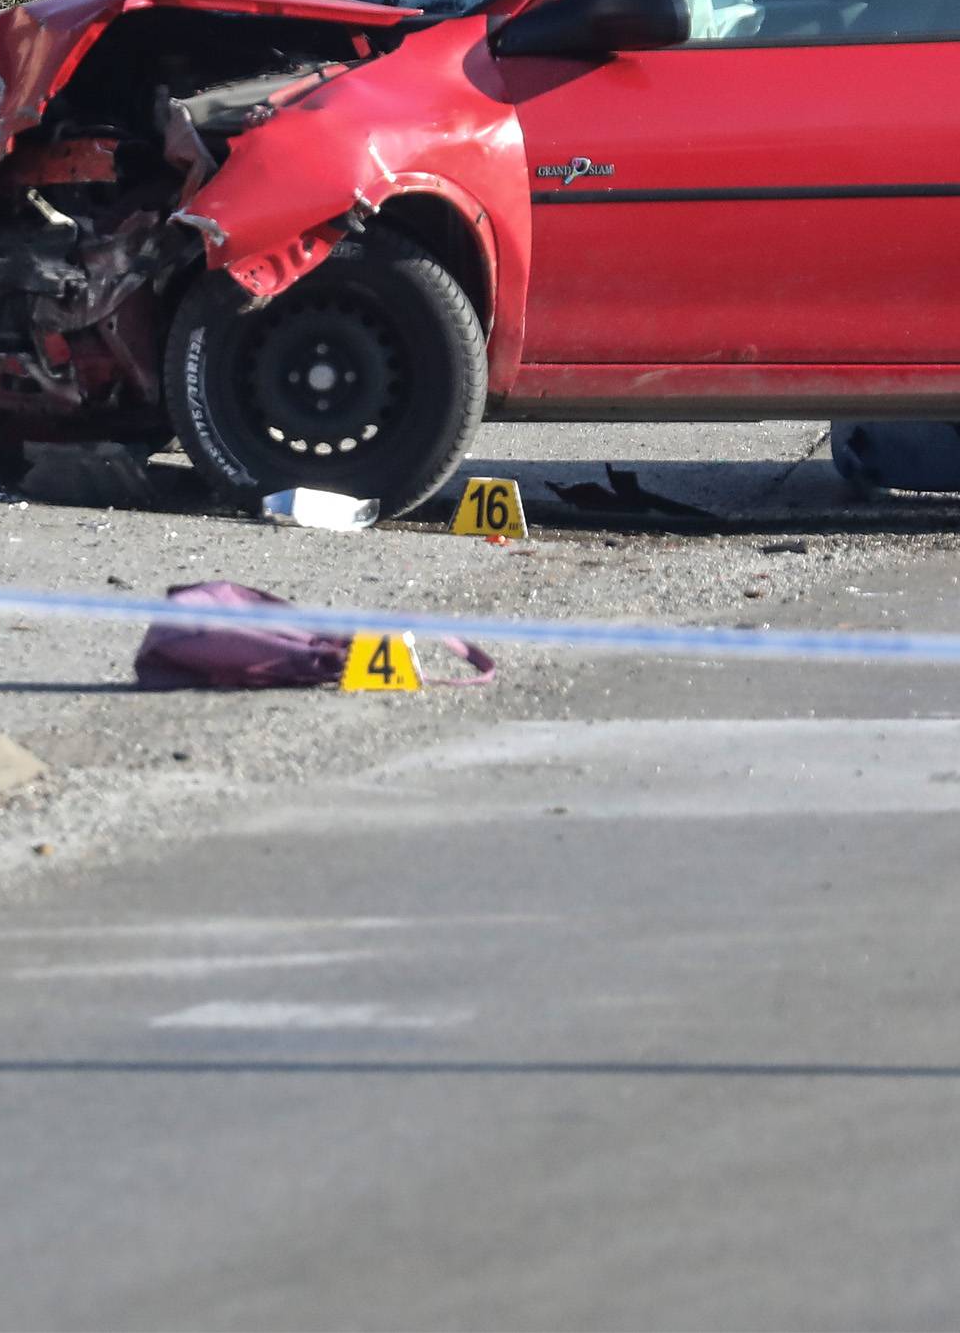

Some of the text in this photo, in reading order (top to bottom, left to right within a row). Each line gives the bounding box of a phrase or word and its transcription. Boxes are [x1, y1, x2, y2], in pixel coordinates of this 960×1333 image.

[538, 165, 615, 177] GRAND SLAM
[470, 484, 508, 529] 16
[367, 634, 396, 684] 4
